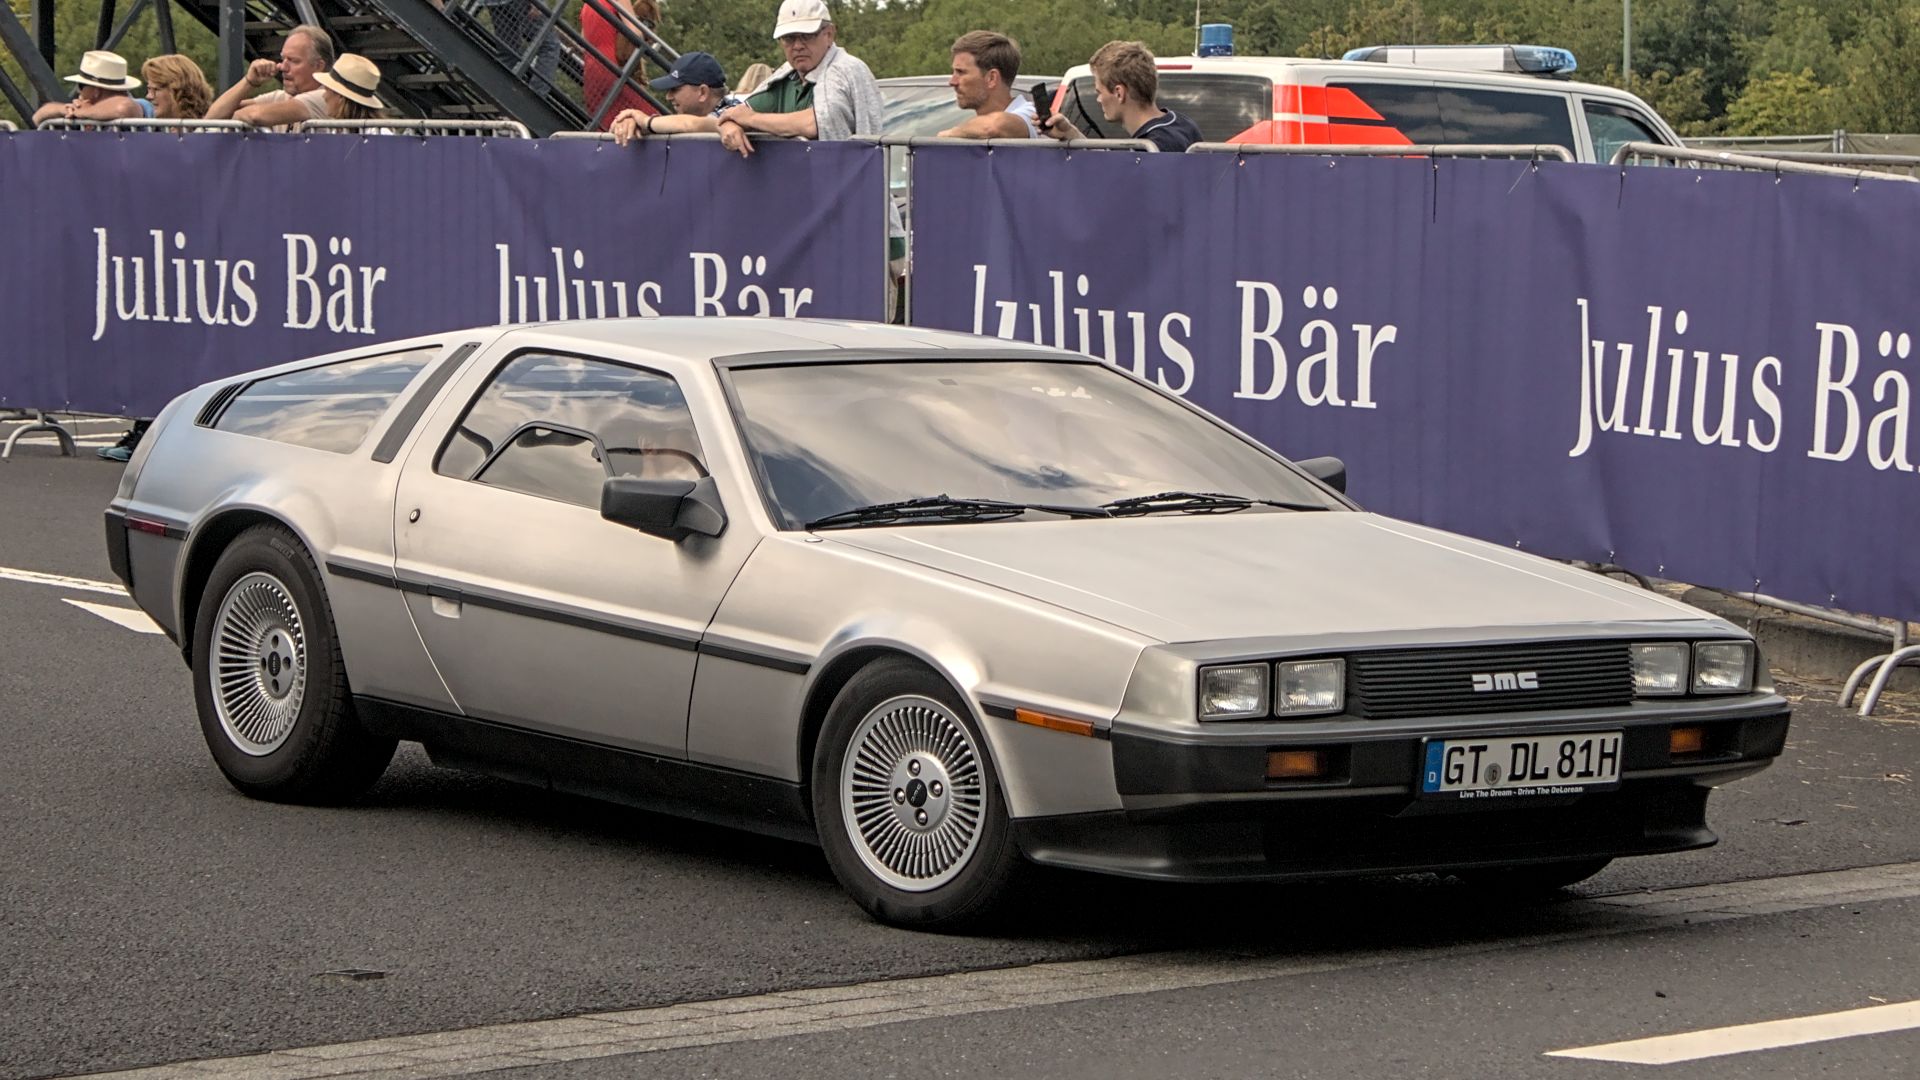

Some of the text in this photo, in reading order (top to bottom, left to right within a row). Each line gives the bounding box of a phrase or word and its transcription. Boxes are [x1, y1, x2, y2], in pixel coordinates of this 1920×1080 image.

[93, 228, 387, 341] Julius Bär
[1233, 281, 1398, 409] Bär
[1568, 298, 1920, 475] Julius Bä
[1428, 736, 1619, 785] D GT DL 81H
[1460, 791, 1474, 799] Live
[1476, 790, 1489, 798] The
[1490, 789, 1513, 797] Dream
[1518, 788, 1535, 796] Drive
[1537, 787, 1550, 795] The
[1551, 786, 1583, 795] DeLorean
